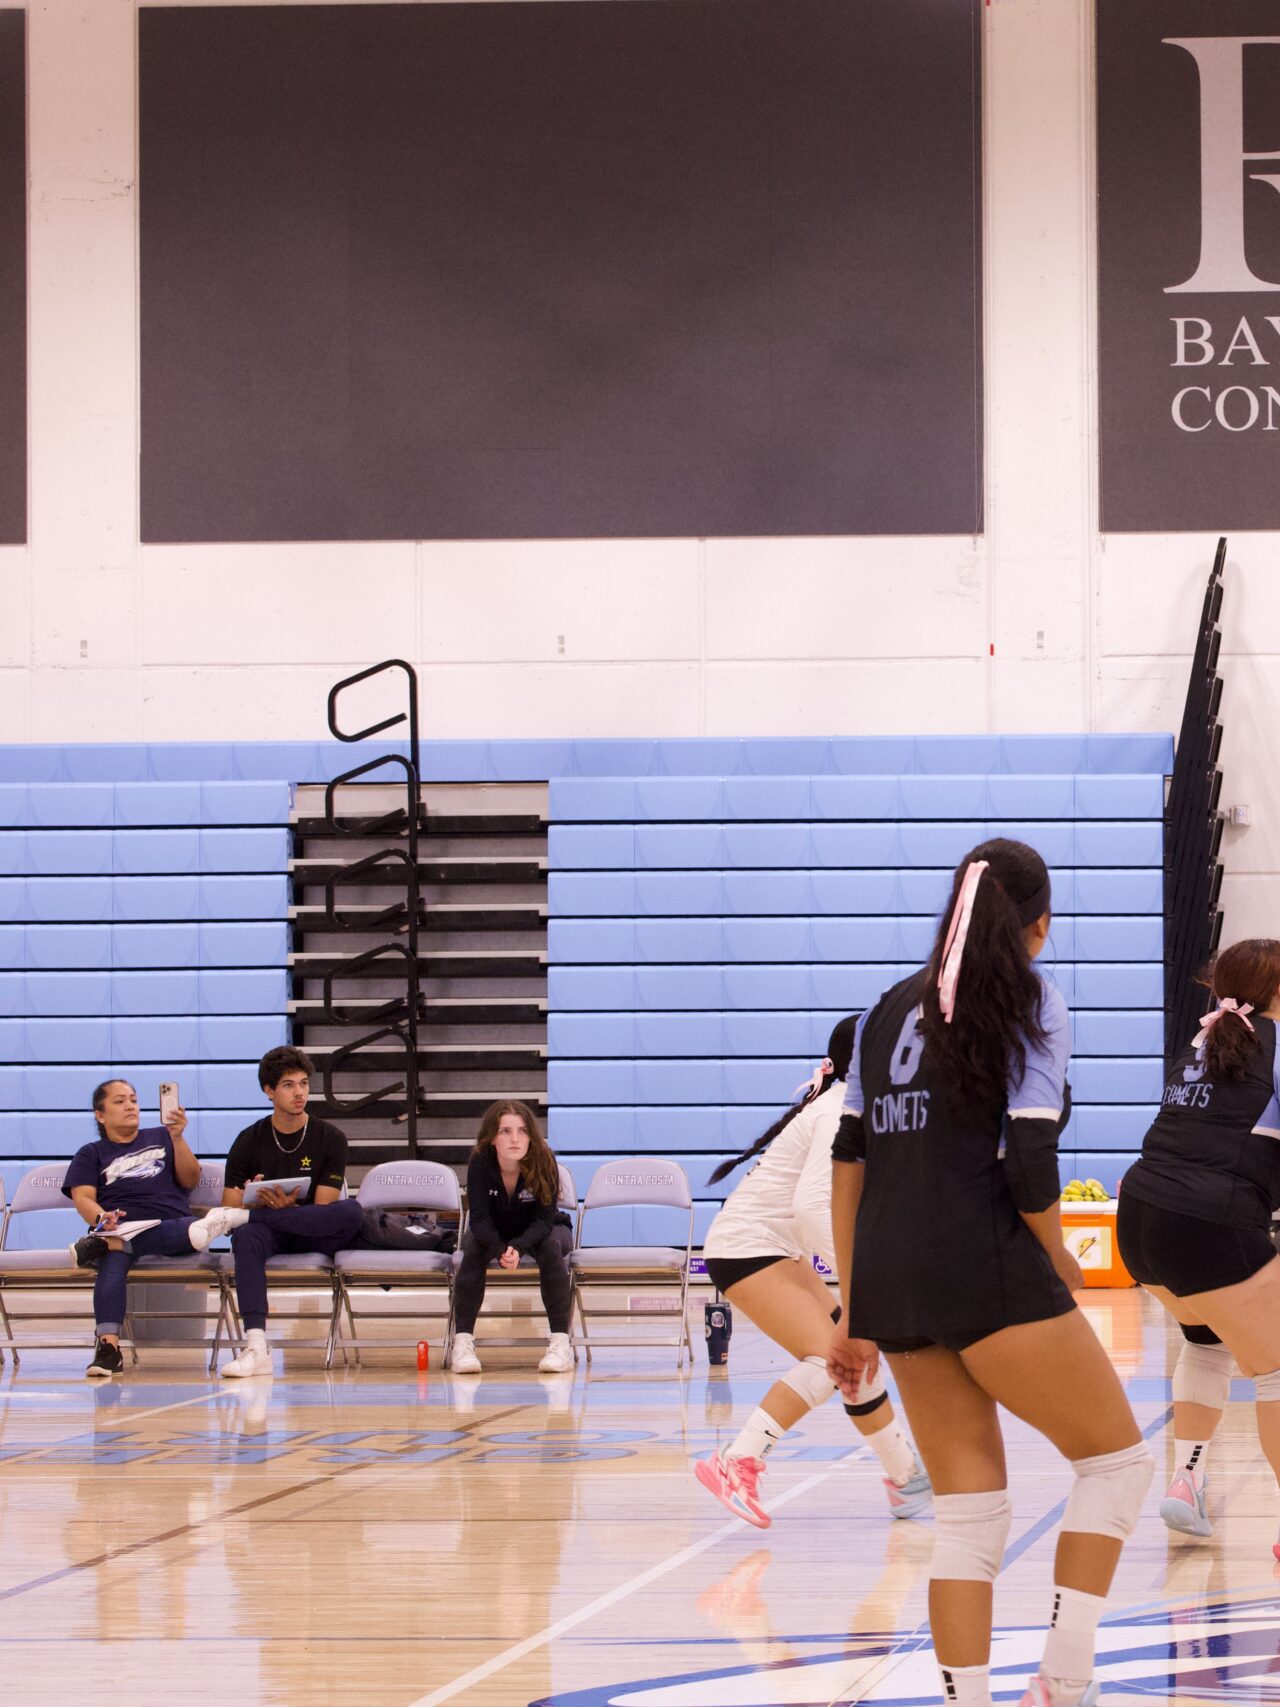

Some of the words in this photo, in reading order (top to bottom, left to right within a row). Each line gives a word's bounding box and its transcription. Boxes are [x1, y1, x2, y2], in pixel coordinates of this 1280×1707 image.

[889, 1004, 925, 1085] 6
[871, 1090, 931, 1134] COMETS
[30, 1176, 63, 1188] CONTR
[197, 1176, 221, 1189] OSTA
[374, 1174, 413, 1186] CONTRA
[415, 1175, 445, 1186] COSTA
[604, 1174, 643, 1186] CONTRA
[645, 1174, 675, 1186] COSTA
